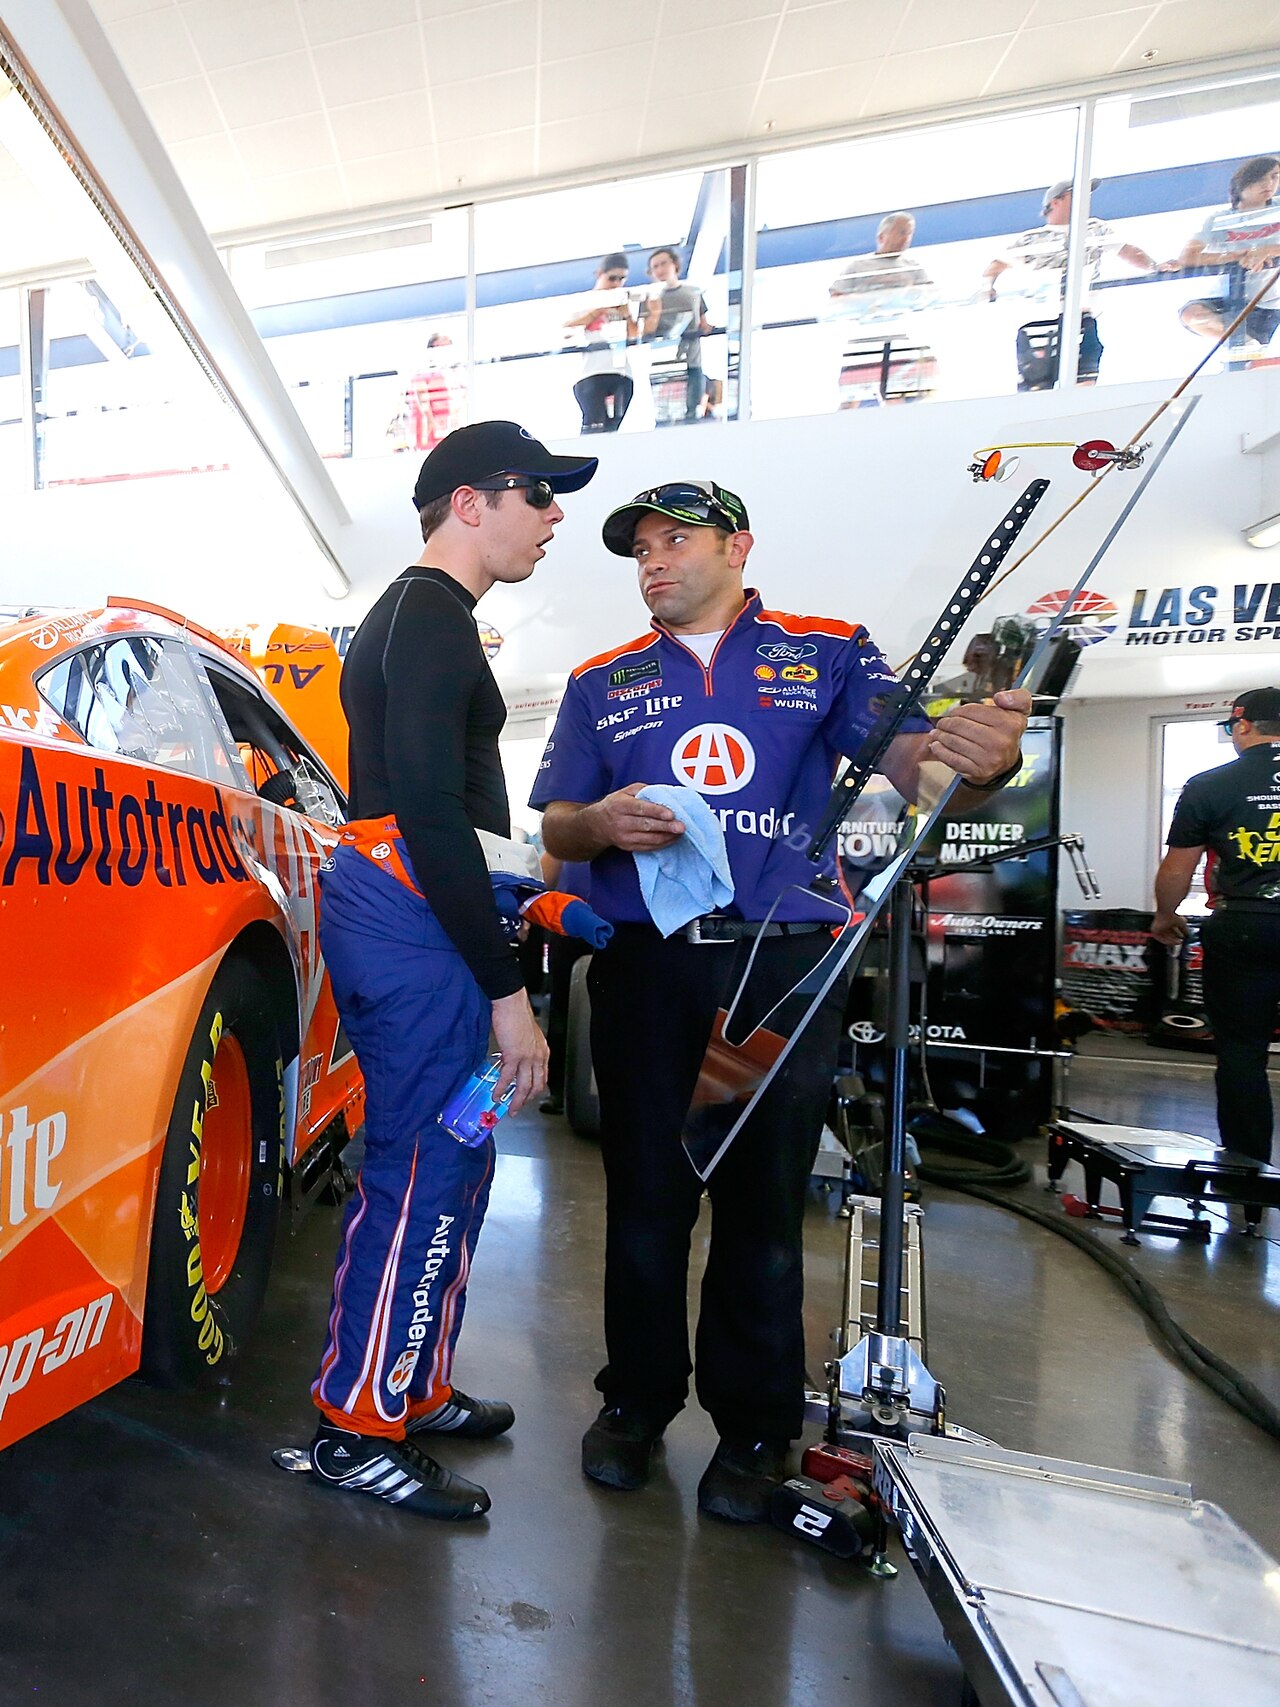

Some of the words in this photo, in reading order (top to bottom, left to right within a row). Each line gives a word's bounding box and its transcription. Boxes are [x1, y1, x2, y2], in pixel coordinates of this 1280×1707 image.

[1128, 585, 1217, 628] LAS
[1126, 628, 1225, 646] MOTOR
[768, 645, 805, 660] Ford
[608, 678, 663, 700] DISCOUNT
[622, 689, 647, 700] TIRE
[644, 695, 683, 716] Lite
[596, 706, 639, 731] SKF
[710, 807, 796, 839] radr
[947, 822, 1025, 842] DENVER
[939, 842, 1031, 863] MATT
[930, 913, 1043, 930] Auto-Owners
[406, 1214, 456, 1350] Autotrader
